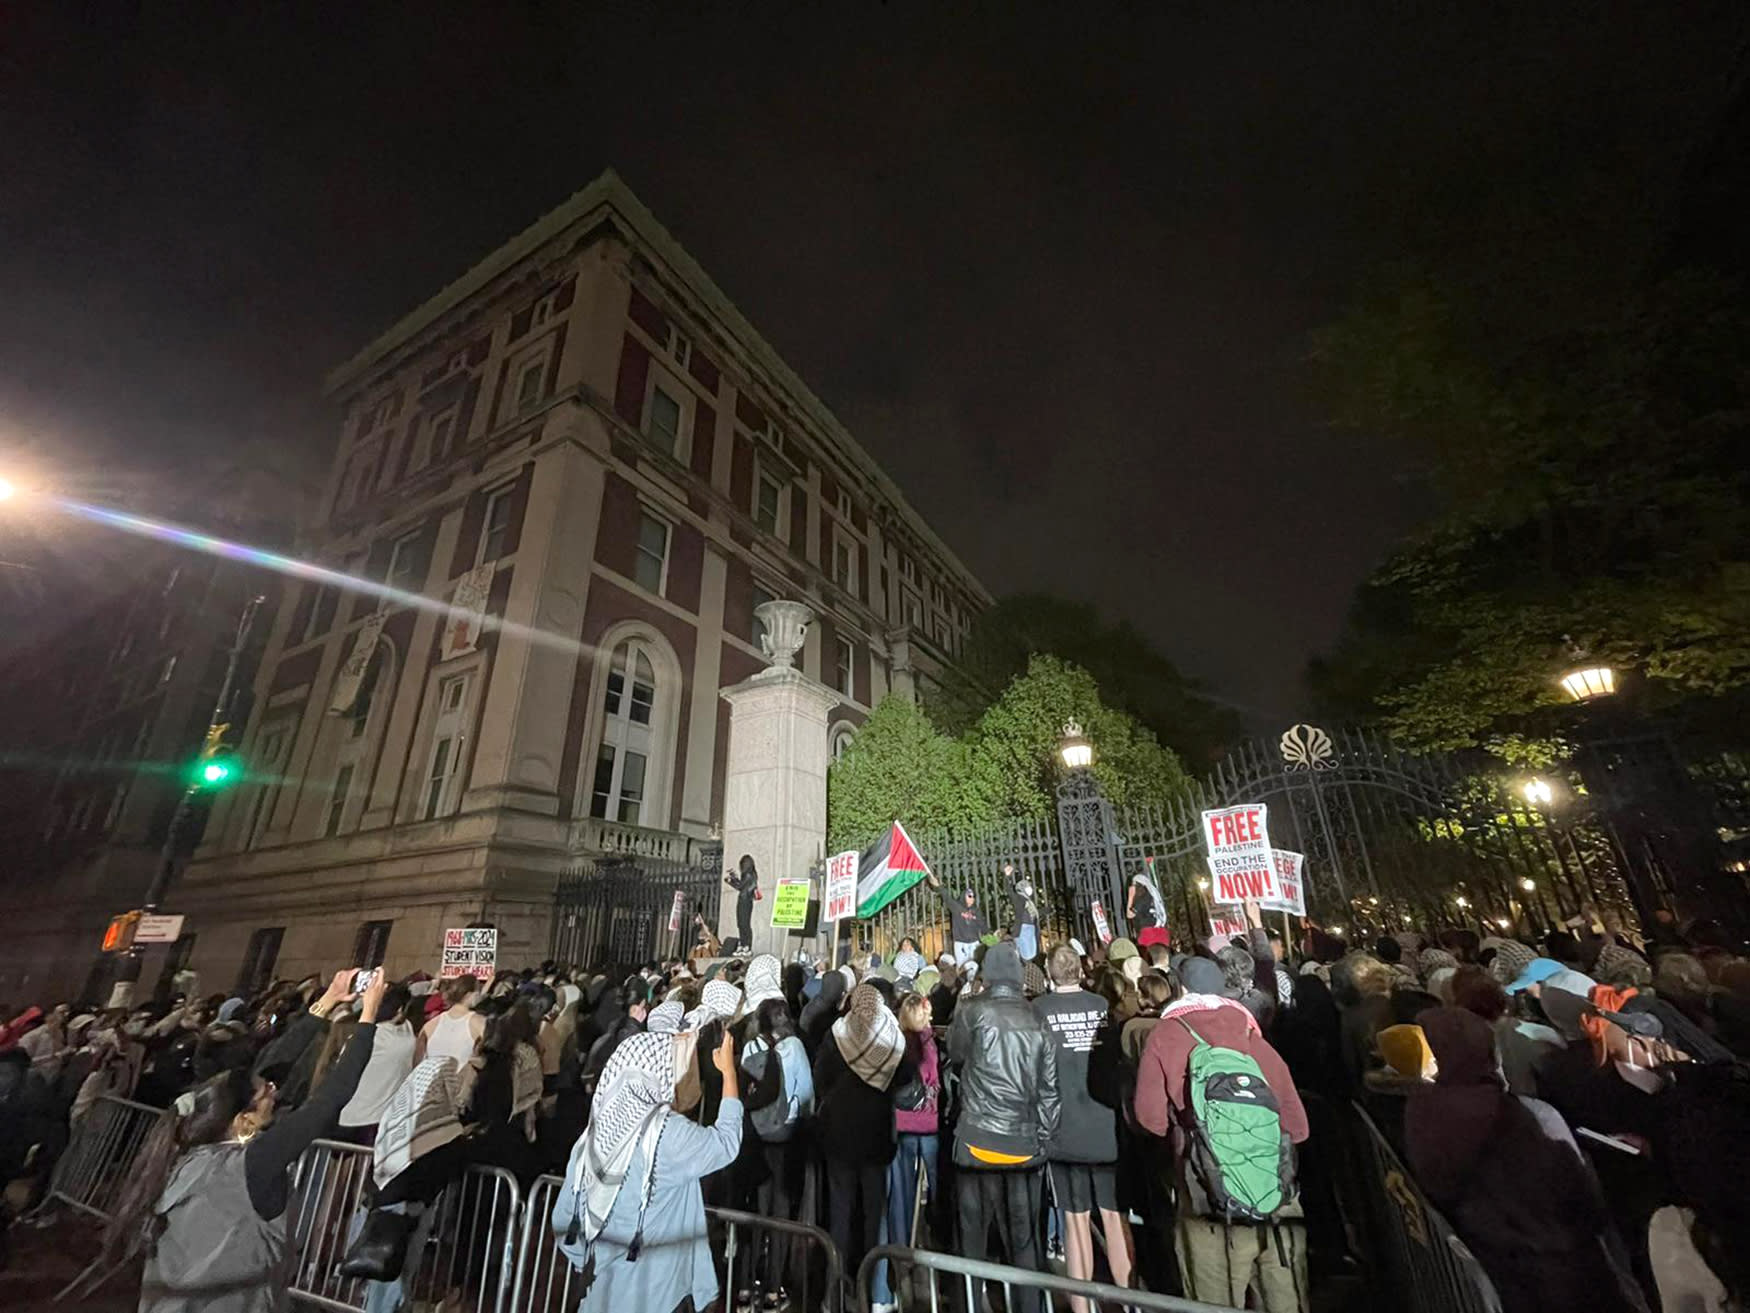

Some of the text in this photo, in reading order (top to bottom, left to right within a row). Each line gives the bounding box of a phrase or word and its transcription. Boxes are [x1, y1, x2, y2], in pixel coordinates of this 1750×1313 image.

[1210, 809, 1262, 846] FREE
[1215, 839, 1264, 854] PALESTINE
[1214, 854, 1266, 868] END THE
[1216, 863, 1268, 874] OCCUPATION
[830, 856, 854, 882] FREE
[1219, 869, 1275, 899] NOW!
[828, 895, 851, 920] NOW!
[444, 950, 494, 964] STUDENT VISION
[442, 966, 470, 976] STUDENT
